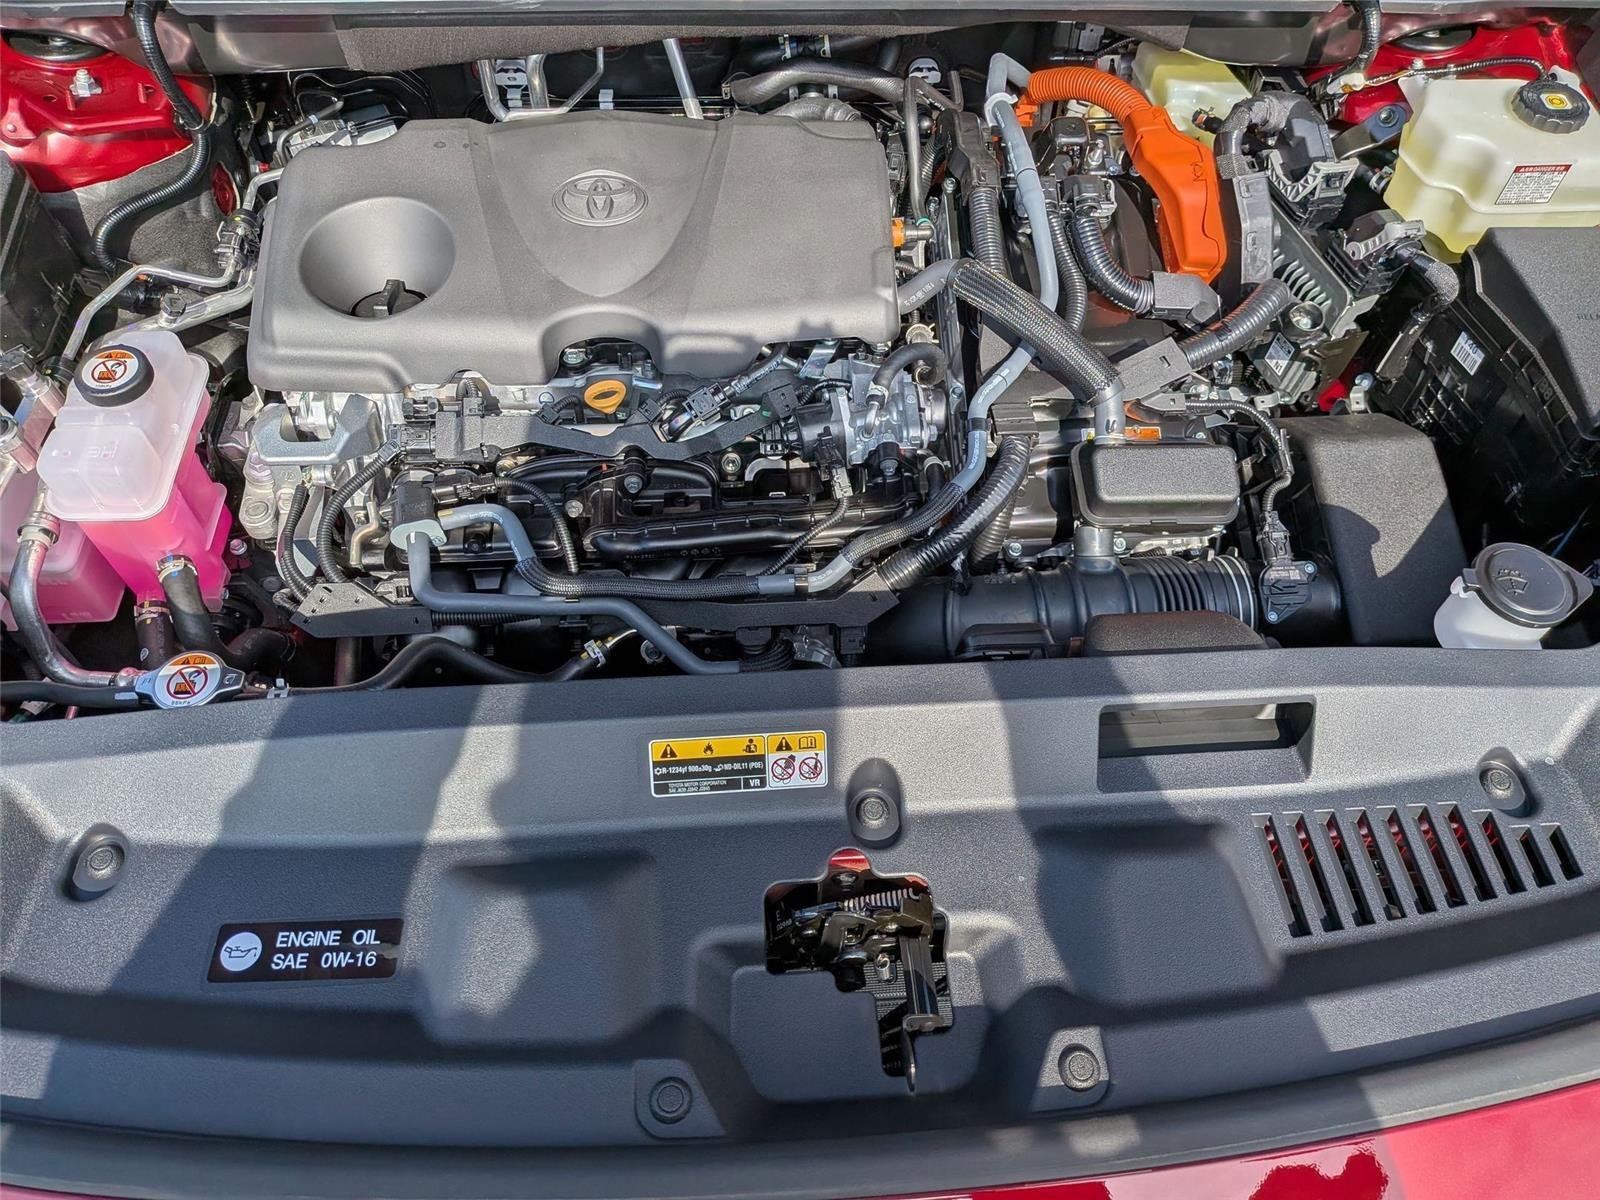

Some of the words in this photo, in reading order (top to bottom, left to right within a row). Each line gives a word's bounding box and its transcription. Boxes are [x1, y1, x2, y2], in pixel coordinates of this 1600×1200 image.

[662, 766, 687, 774] R-1234yf
[748, 761, 764, 769] (POE)
[749, 779, 761, 787] VR
[276, 930, 342, 948] ENGINE
[352, 929, 381, 945] OIL
[271, 953, 308, 970] SAE
[321, 951, 377, 968] 0W-16
